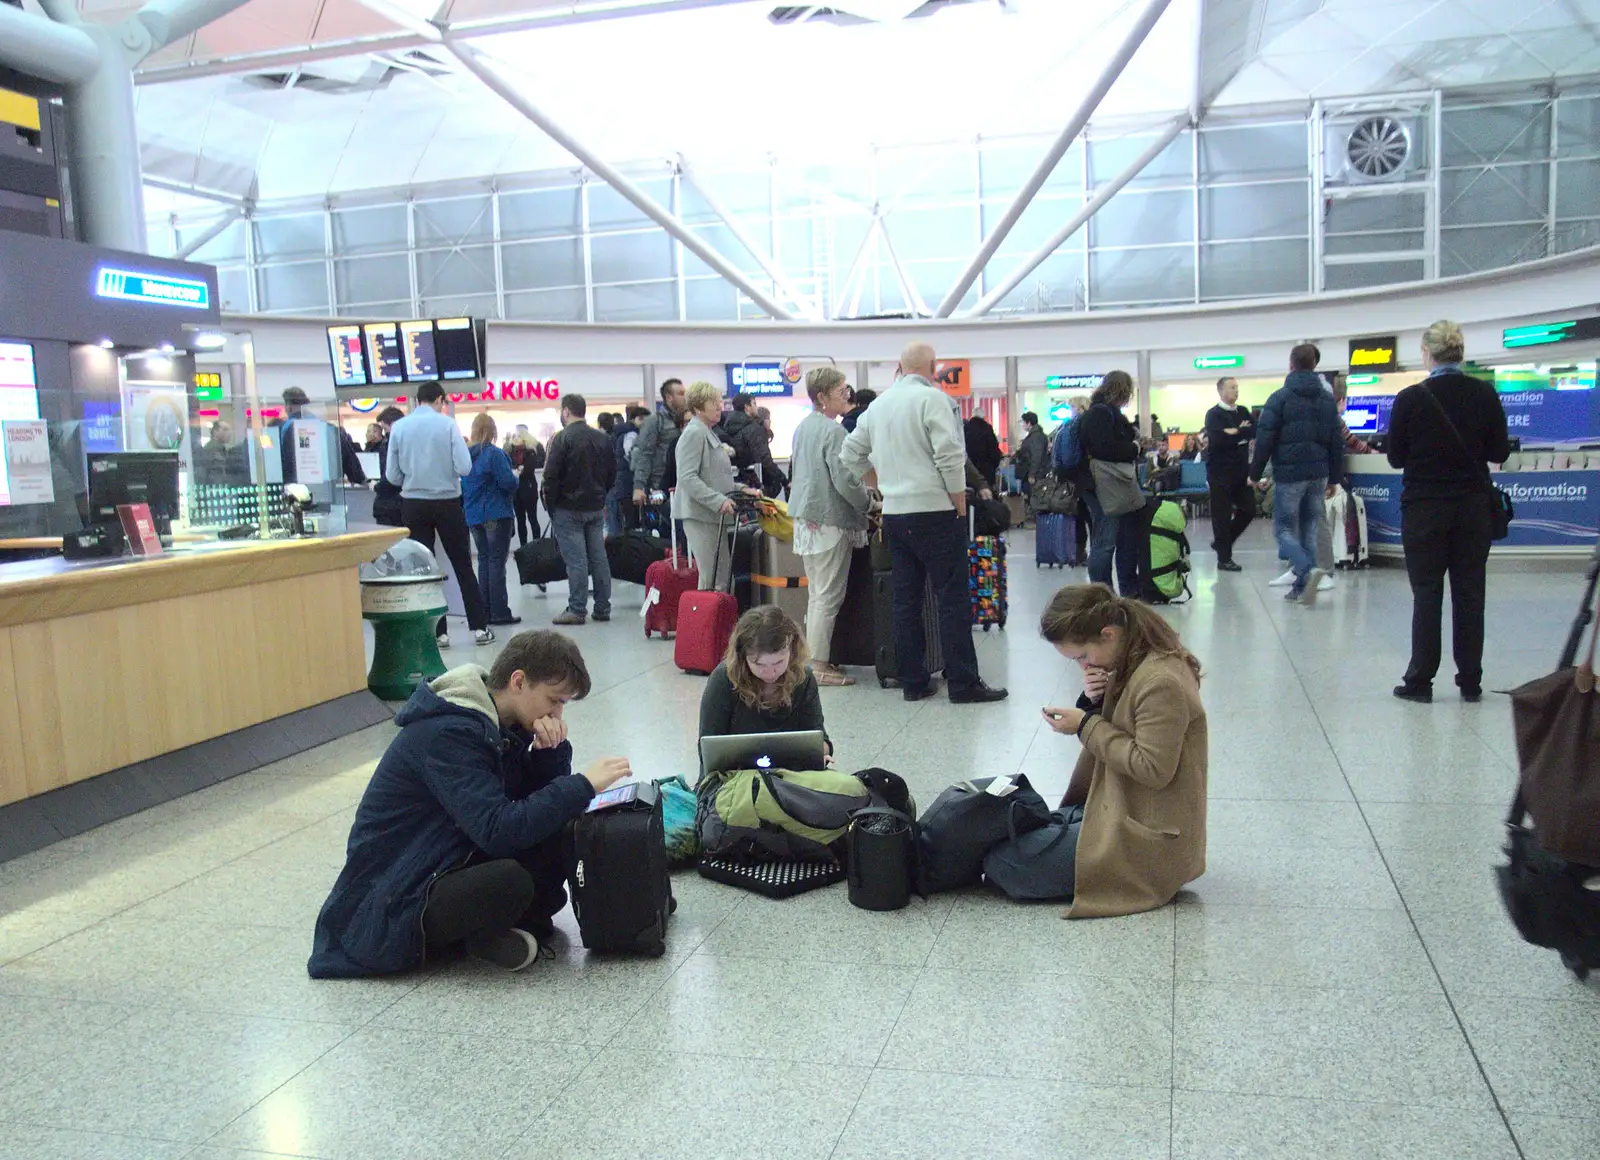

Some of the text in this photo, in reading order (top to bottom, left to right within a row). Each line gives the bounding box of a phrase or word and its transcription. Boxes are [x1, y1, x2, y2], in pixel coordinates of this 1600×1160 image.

[502, 379, 560, 400] KING
[1499, 391, 1544, 402] rmation
[1507, 414, 1530, 427] ERE
